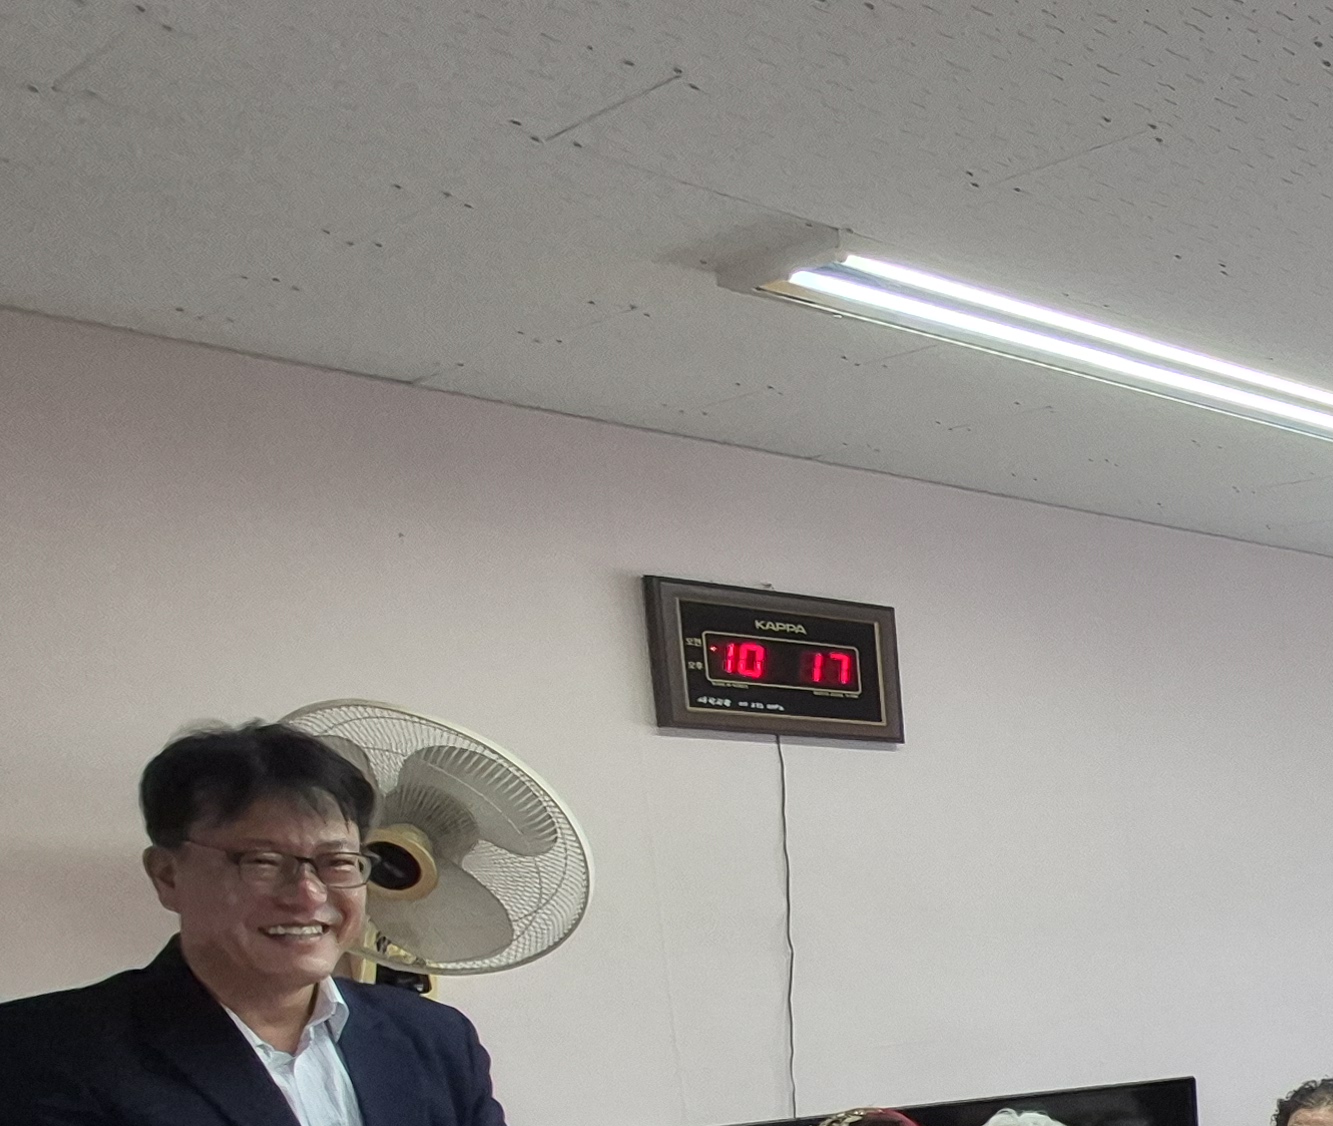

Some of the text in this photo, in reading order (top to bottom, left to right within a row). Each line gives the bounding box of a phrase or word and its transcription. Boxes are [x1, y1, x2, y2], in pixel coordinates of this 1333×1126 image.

[754, 619, 808, 636] KAPPA
[725, 642, 851, 685] 10 17
